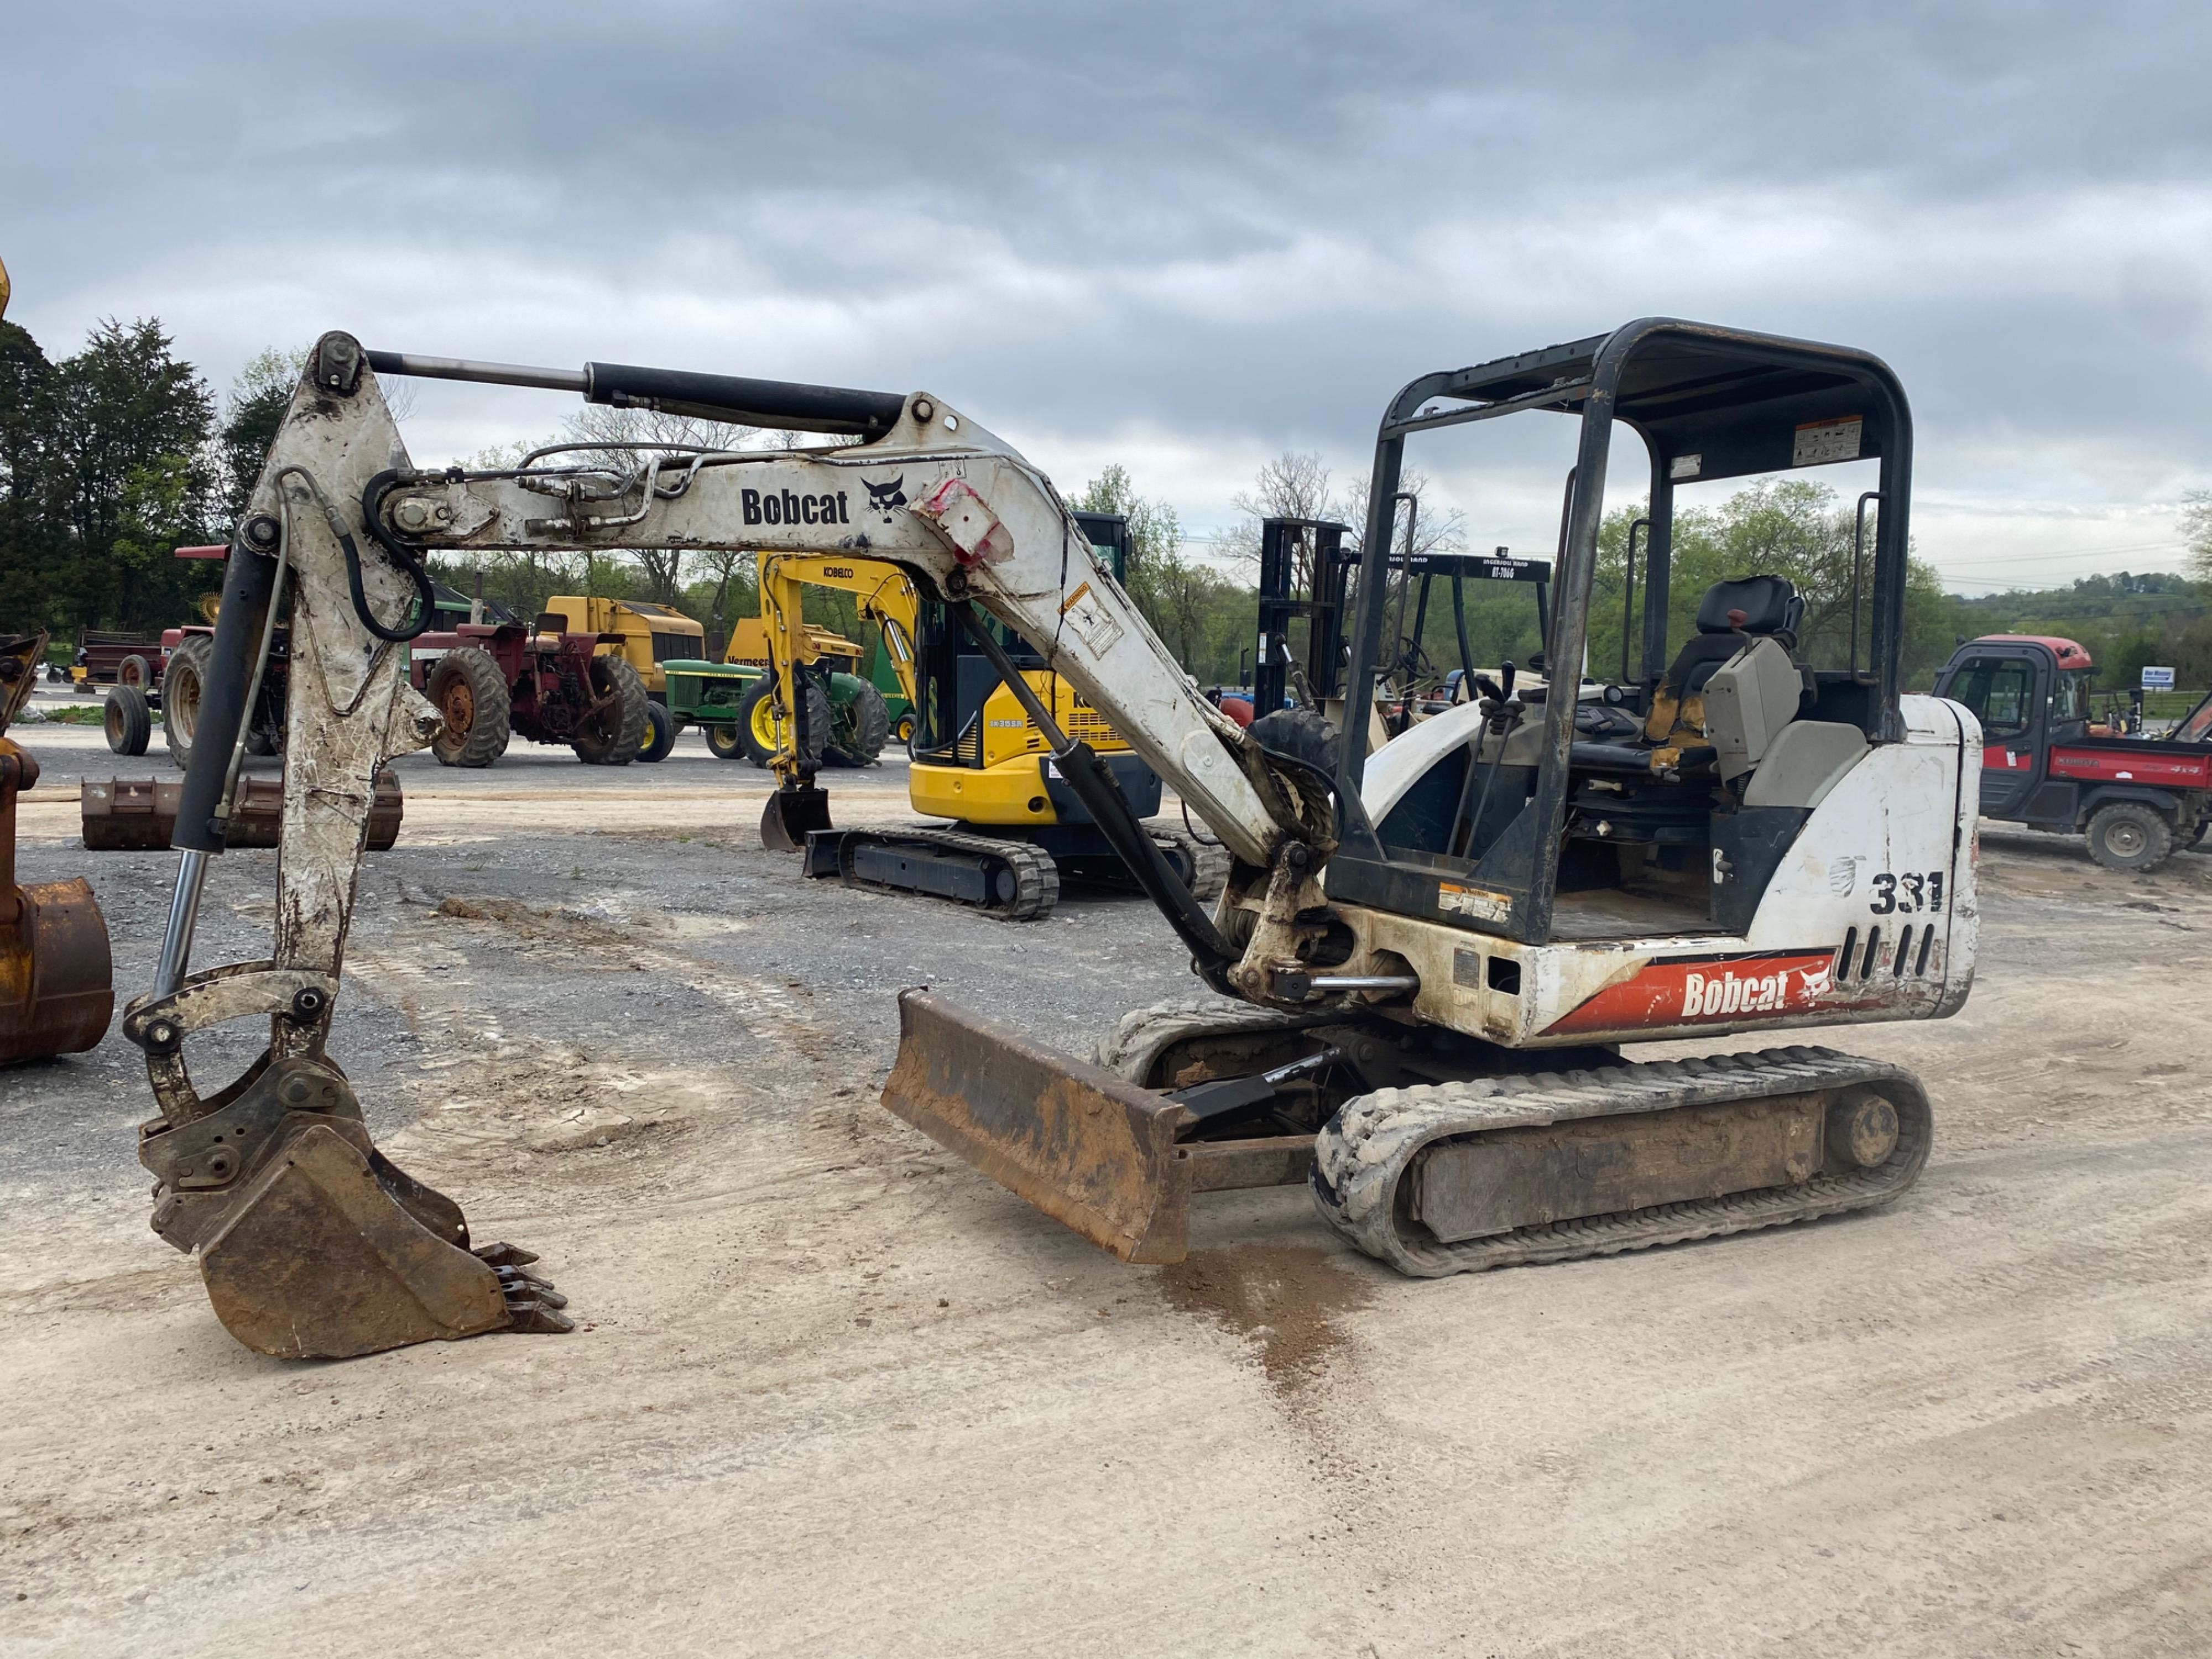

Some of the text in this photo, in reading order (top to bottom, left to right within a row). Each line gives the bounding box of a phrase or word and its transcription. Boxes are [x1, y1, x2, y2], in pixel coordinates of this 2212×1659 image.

[742, 489, 849, 525] Bobcat
[823, 566, 853, 578] KOBELCO
[1065, 585, 1088, 608] WARNING
[728, 655, 769, 666] Vermeer
[1870, 871, 1944, 914] 331
[1681, 971, 1788, 1016] Bobcat
